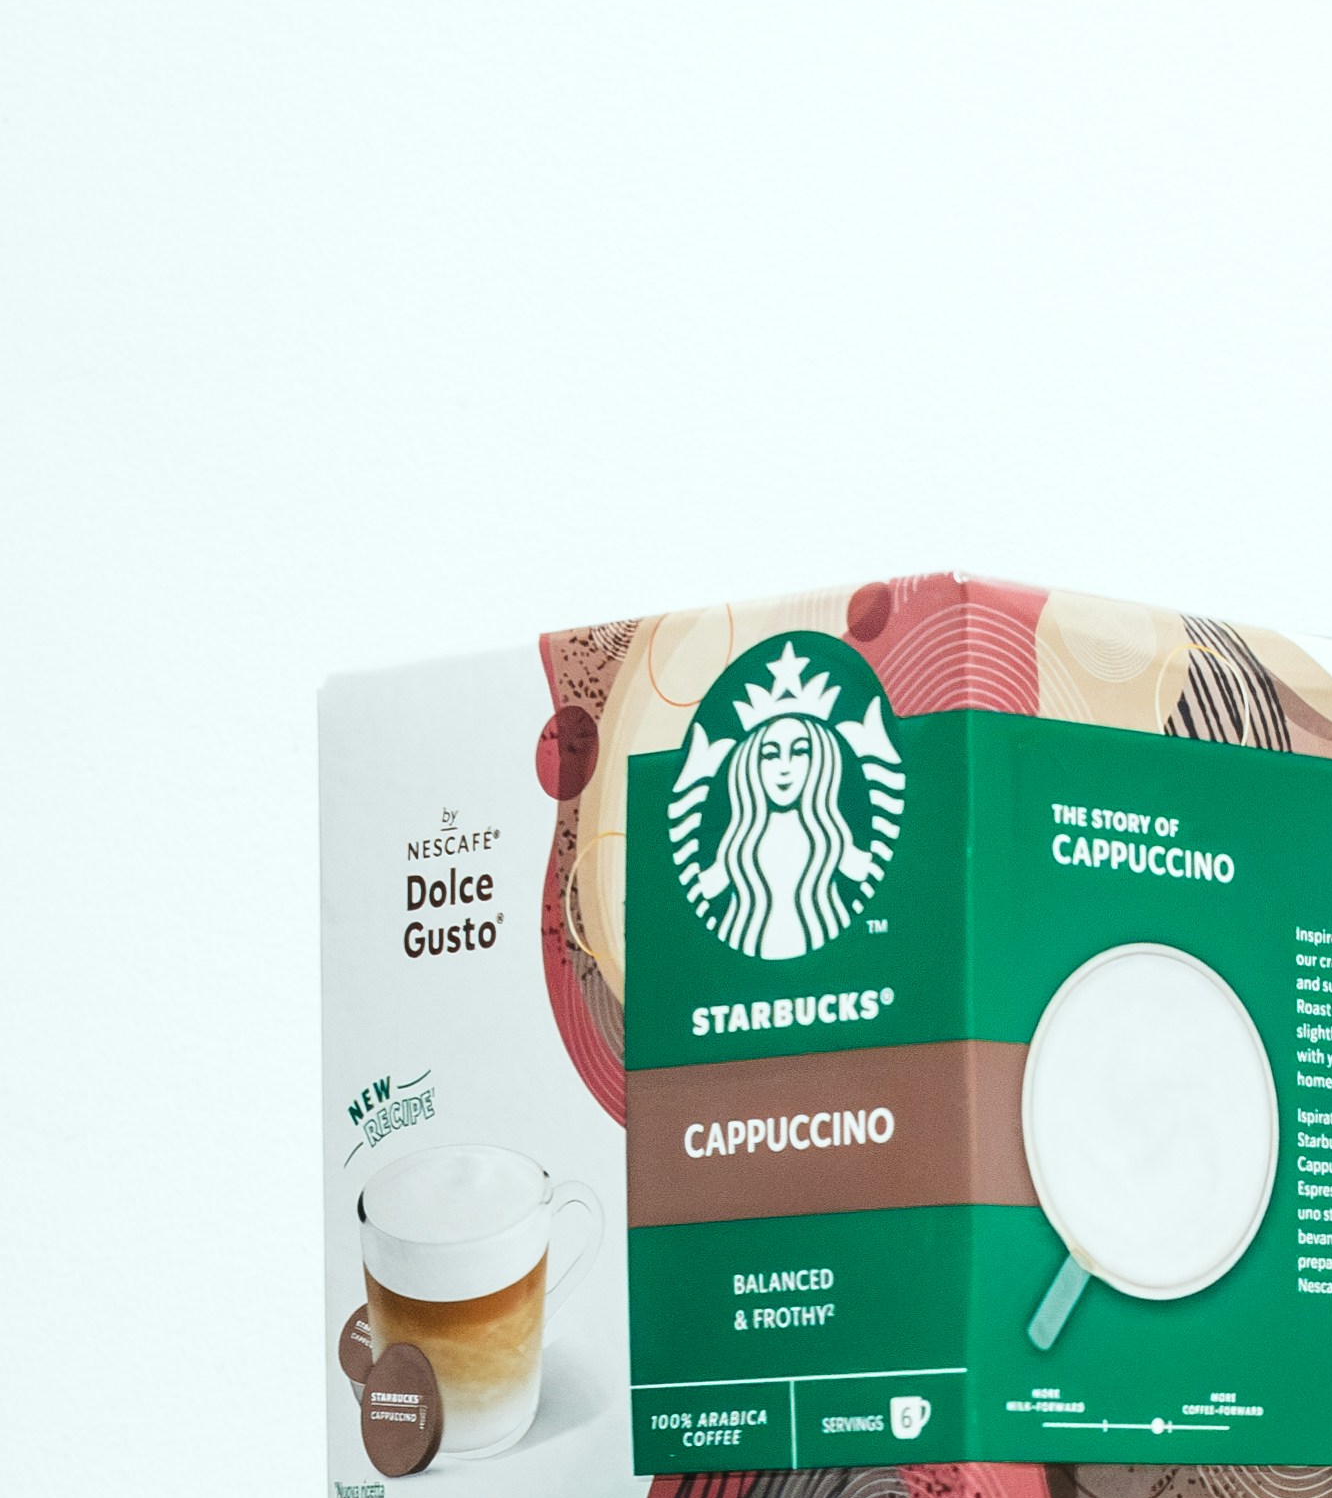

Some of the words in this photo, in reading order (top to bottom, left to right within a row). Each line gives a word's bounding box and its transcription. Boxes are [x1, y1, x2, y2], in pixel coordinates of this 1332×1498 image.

[441, 807, 459, 827] by
[1052, 804, 1087, 826] THE
[1092, 809, 1150, 834] STORY
[1155, 817, 1178, 837] OF
[1053, 835, 1234, 882] CAPPUCCINO
[407, 868, 493, 911] Dolce
[1296, 954, 1317, 966] our
[1297, 977, 1320, 991] and
[1297, 999, 1331, 1016] Roast
[1298, 1049, 1324, 1063] with
[347, 1075, 391, 1126] NEW
[684, 1107, 894, 1158] CAPPUCCINO
[734, 1269, 833, 1295] BALANCED
[735, 1310, 747, 1330] &
[651, 1411, 694, 1430] 100%
[698, 1410, 766, 1427] ARABICA
[823, 1415, 884, 1433] SERVINGS
[901, 1407, 912, 1428] 6
[683, 1430, 741, 1446] COFFEE
